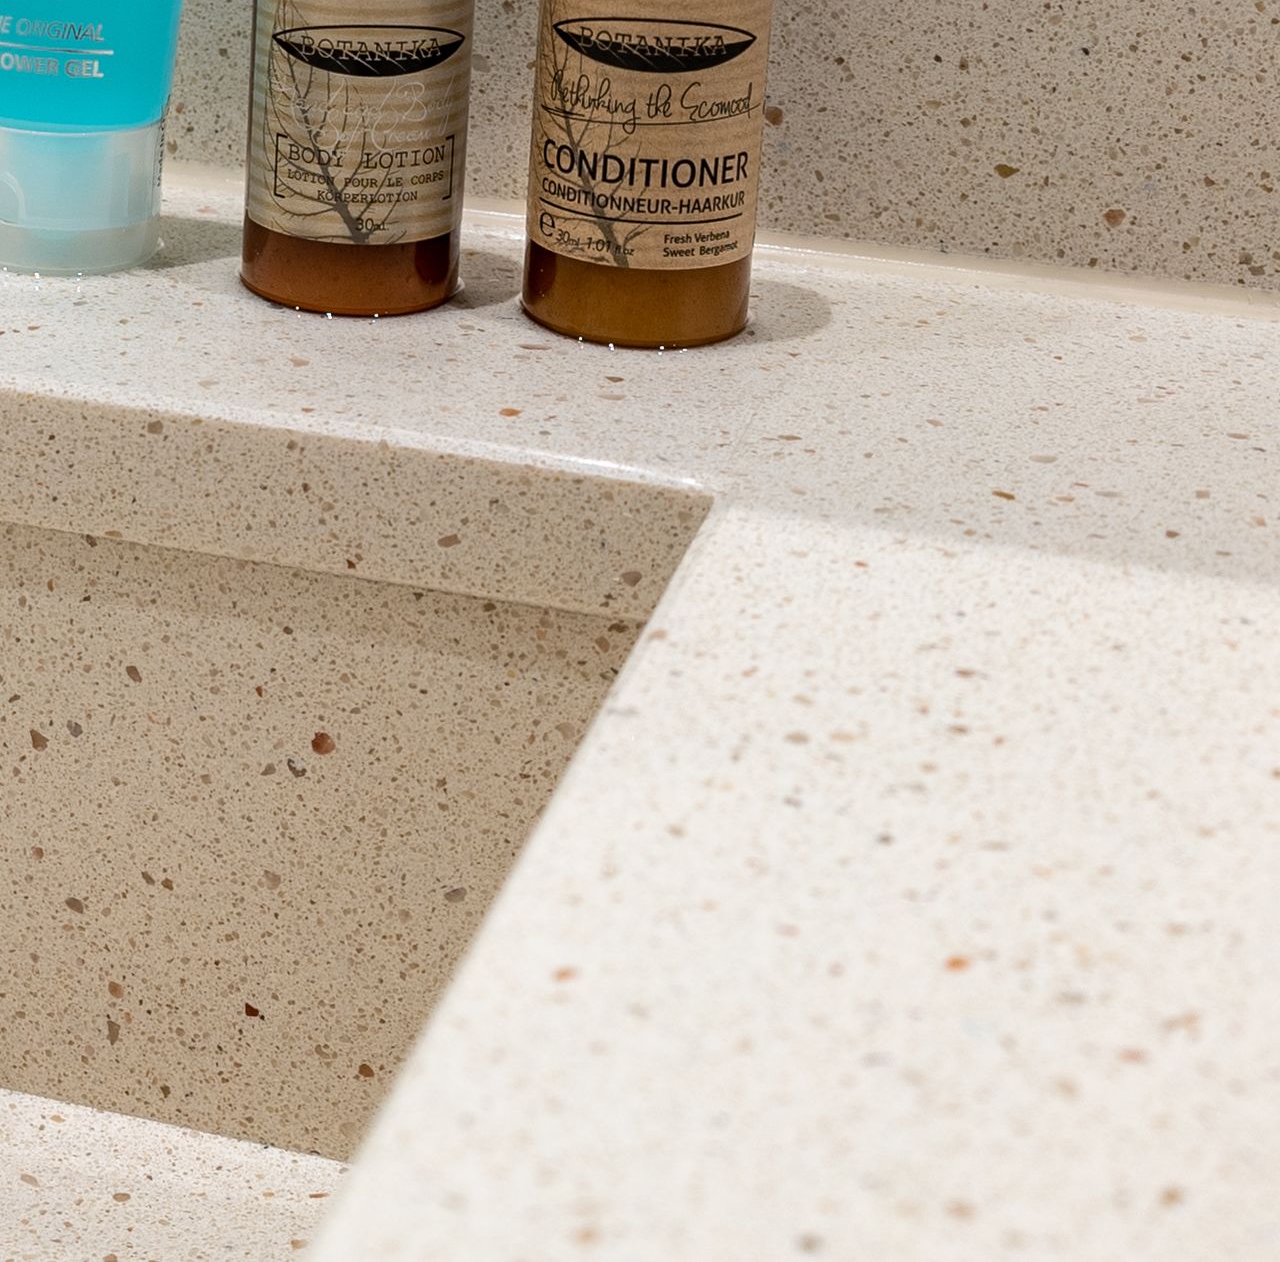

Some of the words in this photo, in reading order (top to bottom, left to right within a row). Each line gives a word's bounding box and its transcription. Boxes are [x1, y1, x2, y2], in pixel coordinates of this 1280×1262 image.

[16, 18, 105, 42] ORIGINAL
[579, 26, 728, 58] BOTANIKA
[301, 35, 442, 62] BOTANIKA
[64, 59, 105, 79] GEL
[646, 84, 673, 118] the
[288, 143, 345, 169] BODY
[362, 145, 446, 170] LOTION
[543, 138, 749, 188] CONDITIONER
[287, 168, 335, 186] LOTION
[344, 178, 378, 189] POUR
[387, 177, 403, 188] LE
[411, 170, 445, 186] CORPS
[317, 189, 418, 205] KÖRPERLOTION
[542, 177, 745, 215] CONDITIONNEUR-HAARKUR
[663, 233, 693, 245] Fresh
[693, 229, 730, 244] Verbena
[663, 246, 695, 258] Sweet
[698, 239, 739, 257] Bergamot
